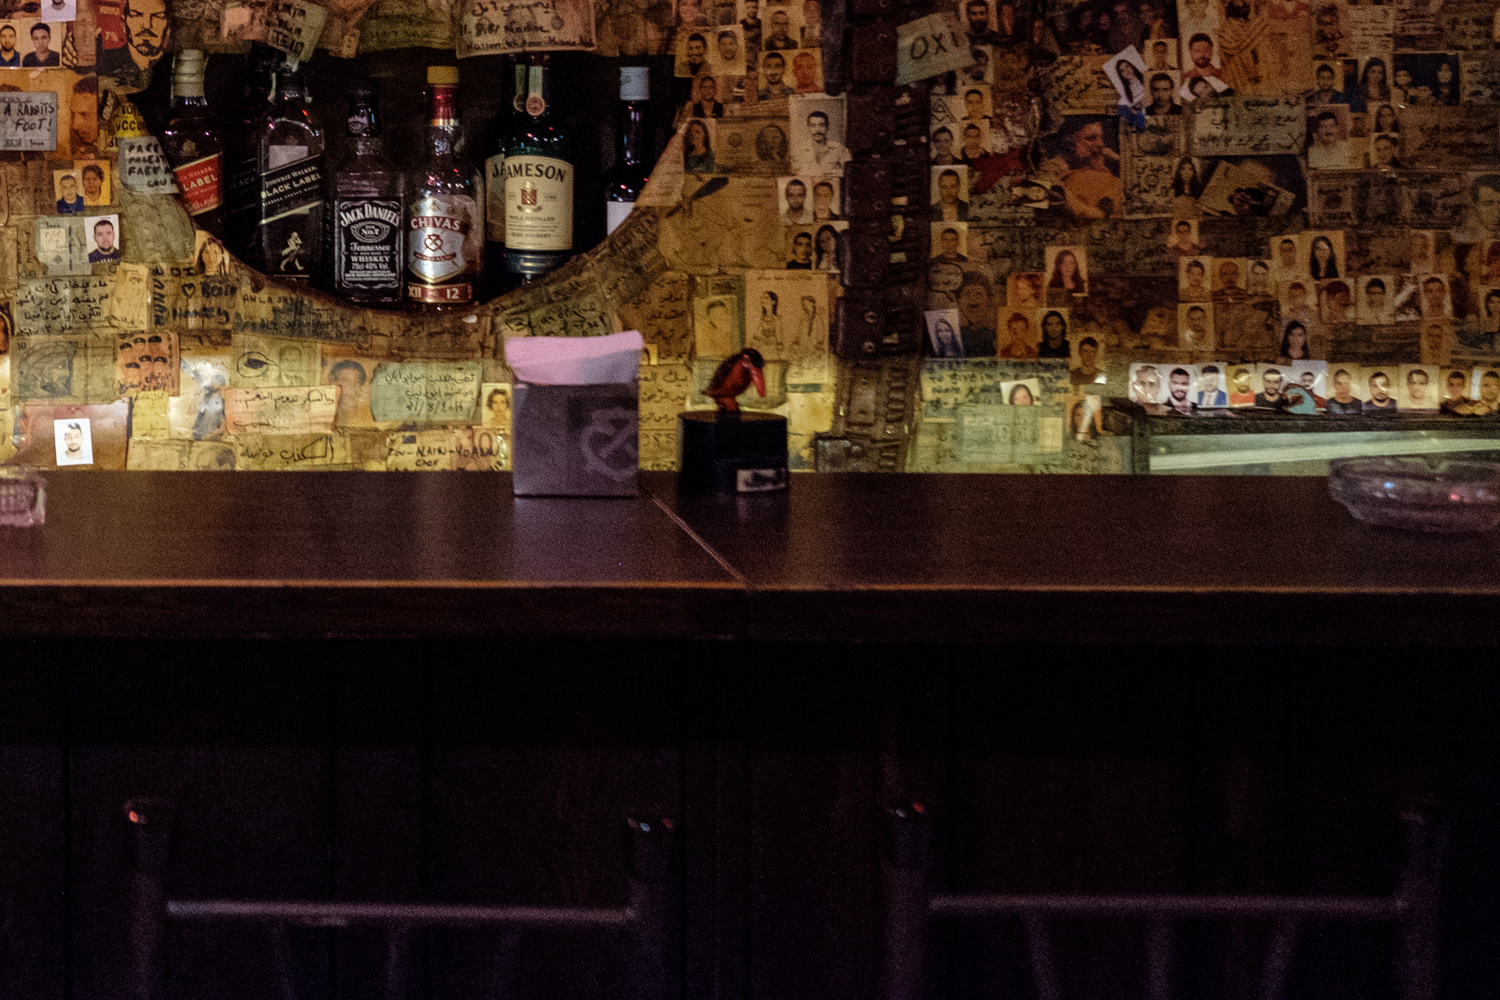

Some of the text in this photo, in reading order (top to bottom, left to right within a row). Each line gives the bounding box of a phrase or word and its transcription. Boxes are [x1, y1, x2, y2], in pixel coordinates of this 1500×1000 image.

[182, 173, 219, 192] LABEL
[292, 172, 322, 189] LABEL
[340, 205, 364, 227] JACK
[410, 217, 462, 231] CHIVAS
[349, 241, 392, 252] Tennessee
[350, 254, 392, 263] WHISKEY
[445, 287, 461, 300] 12
